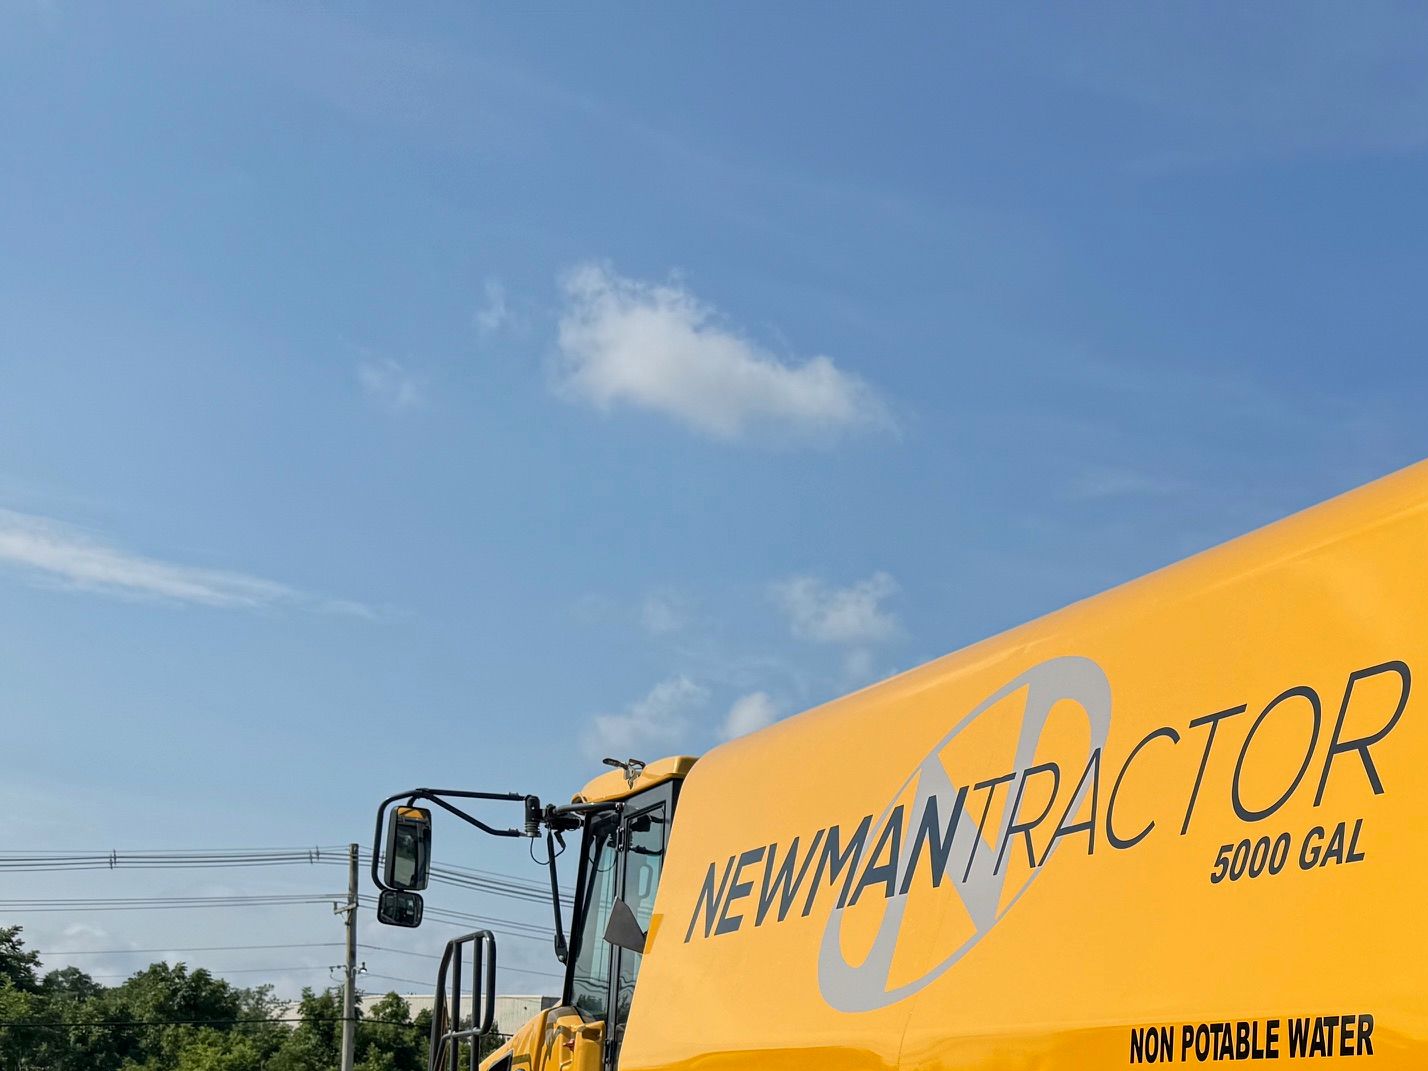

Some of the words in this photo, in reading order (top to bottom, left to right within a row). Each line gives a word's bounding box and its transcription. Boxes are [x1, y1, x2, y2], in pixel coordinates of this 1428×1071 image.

[1210, 832, 1292, 884] 5000
[1299, 819, 1365, 870] GAL
[1129, 1026, 1175, 1064] NON
[1181, 1020, 1280, 1062] POTABLE
[1287, 1014, 1374, 1058] WATER
